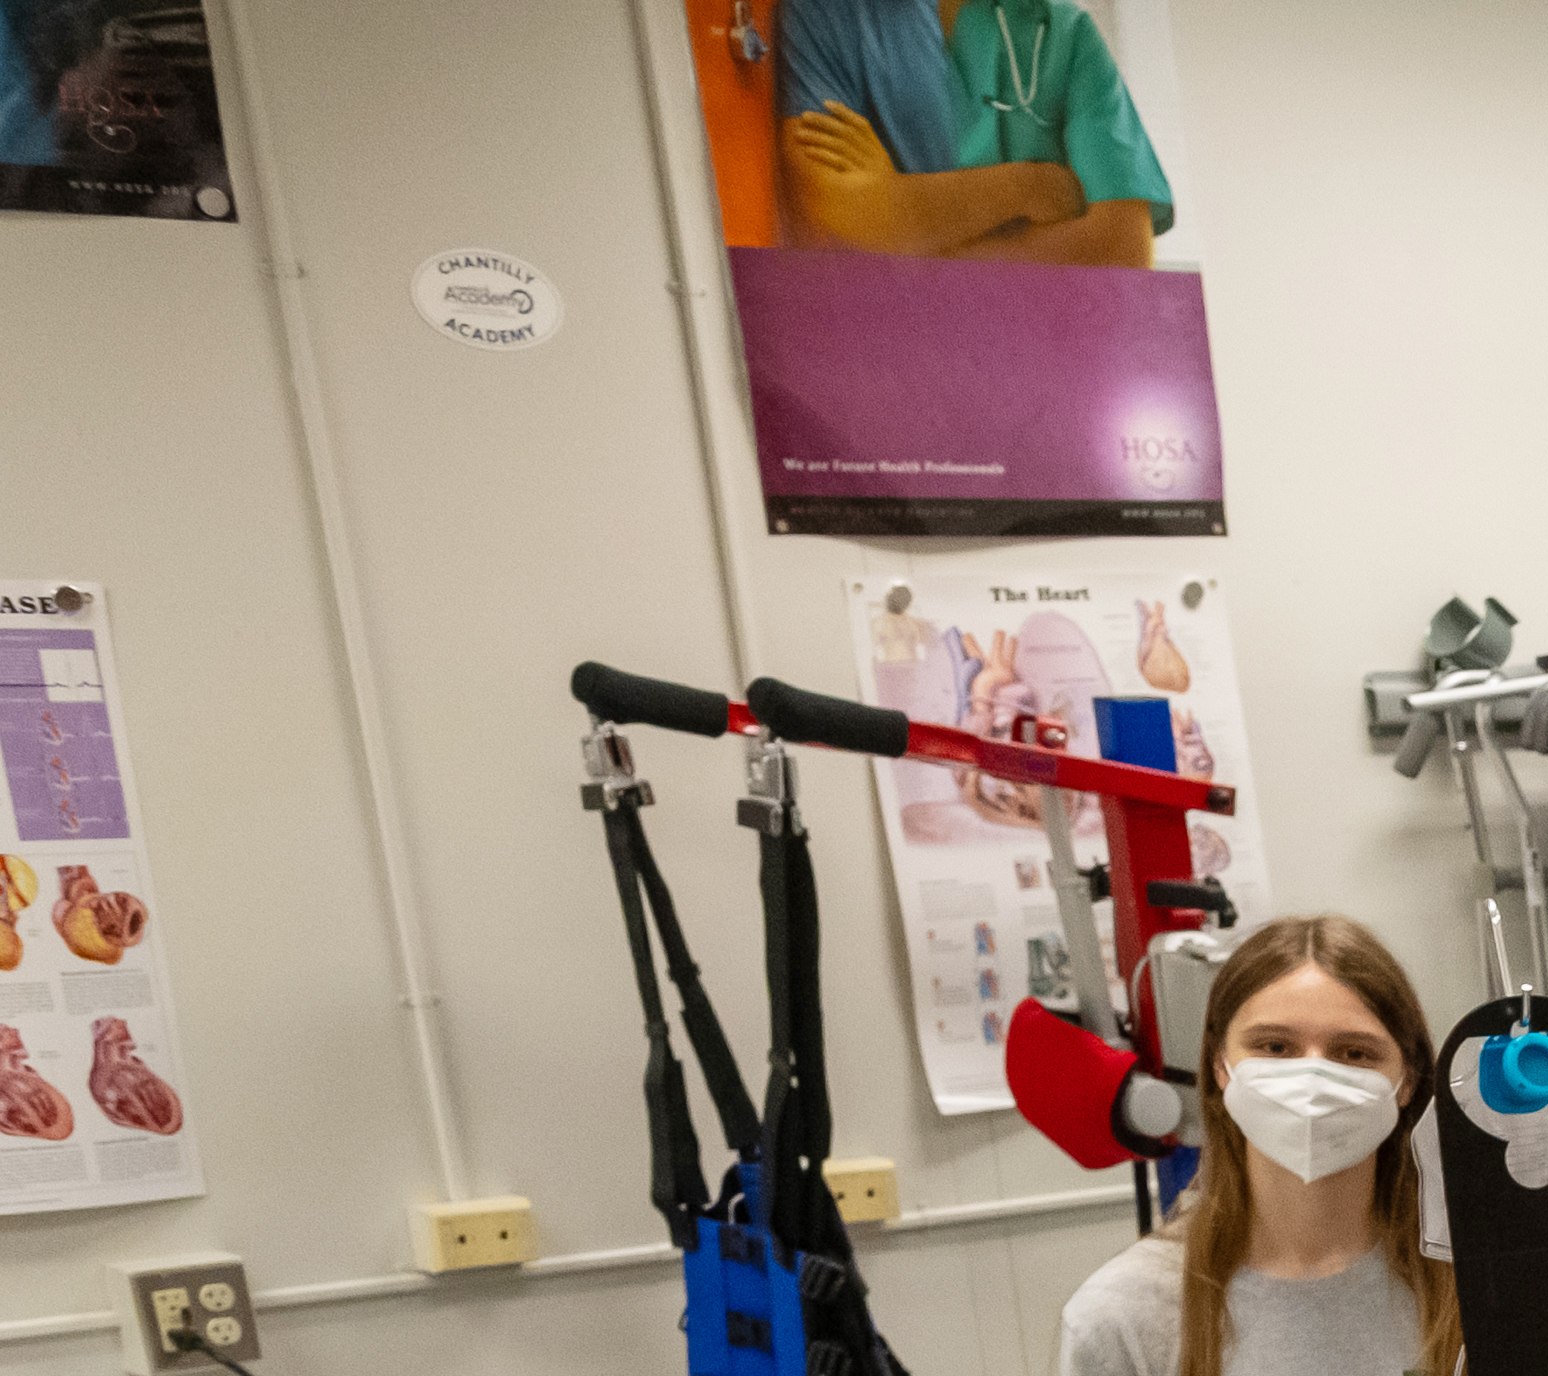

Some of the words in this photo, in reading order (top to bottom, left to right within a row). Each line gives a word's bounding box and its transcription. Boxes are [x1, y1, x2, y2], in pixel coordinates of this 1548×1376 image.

[438, 257, 535, 284] CHANTILLY
[444, 319, 535, 344] ACADEMY
[1120, 437, 1199, 462] HOSA
[989, 586, 1028, 603] The
[1037, 585, 1091, 601] Heart
